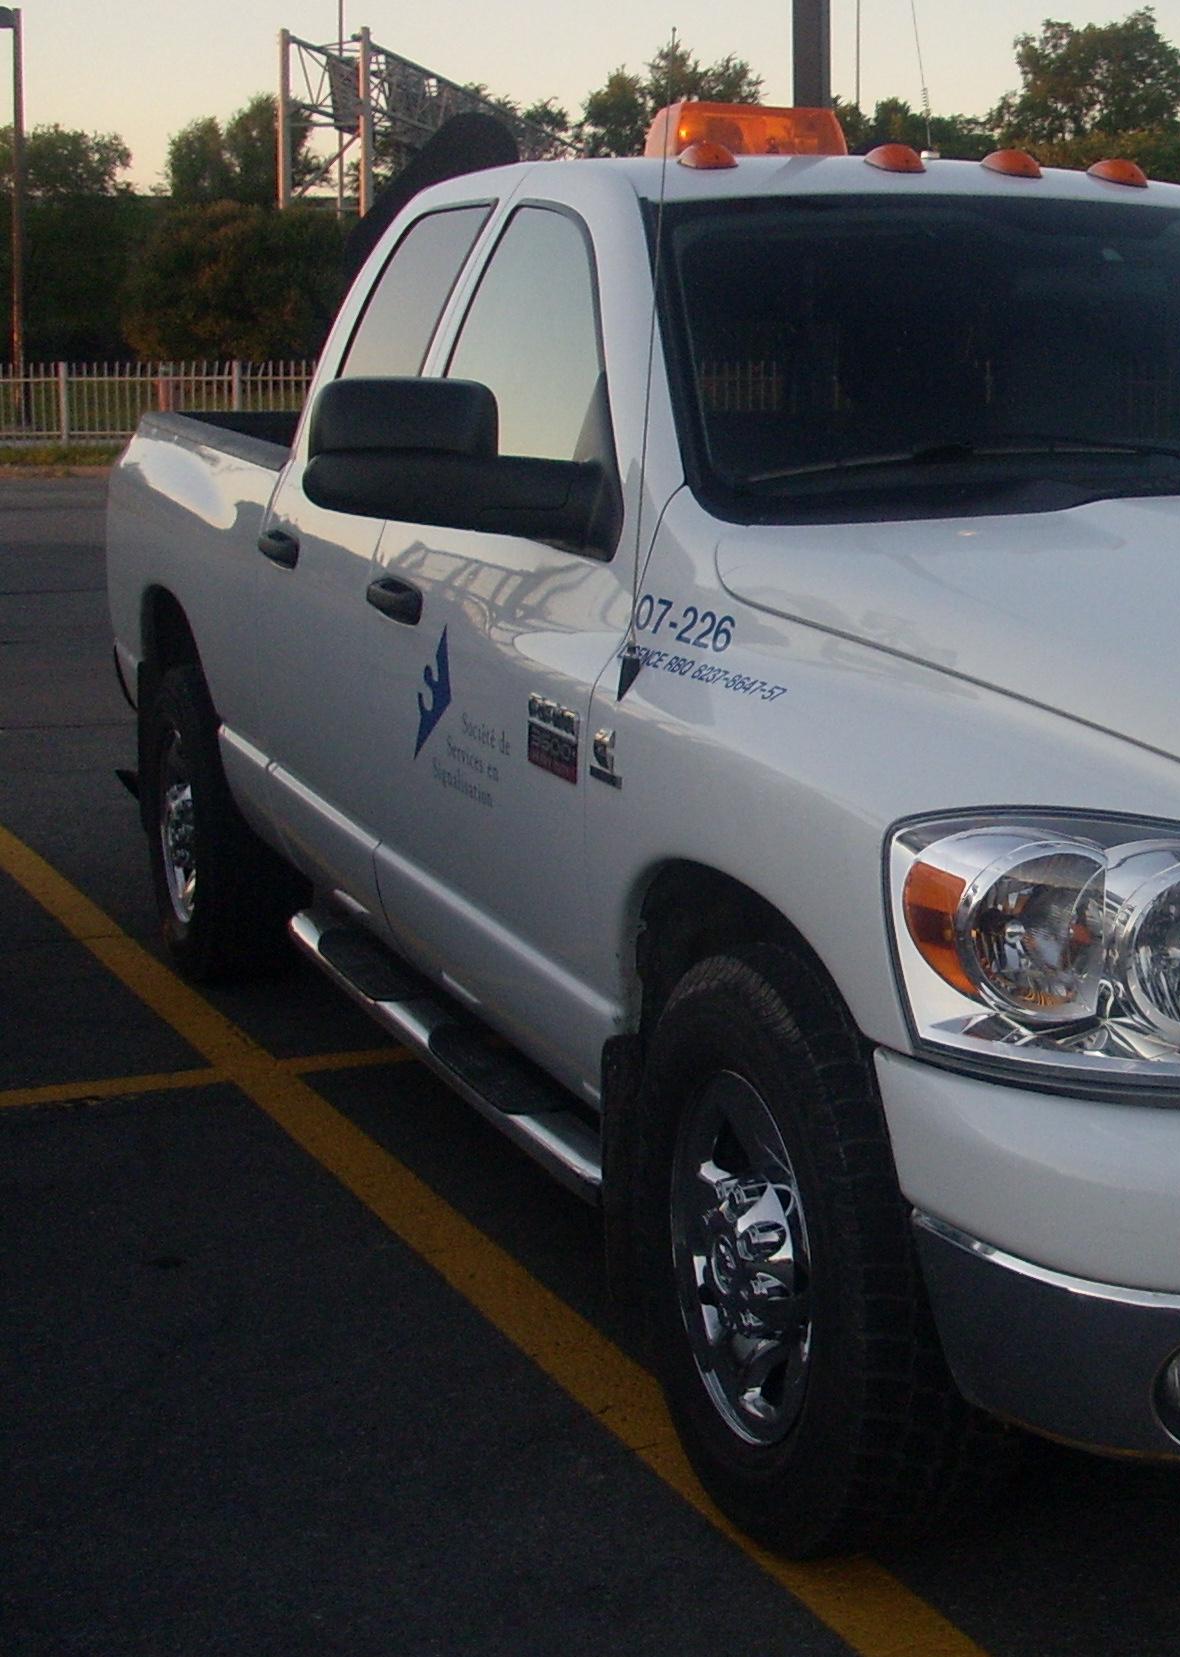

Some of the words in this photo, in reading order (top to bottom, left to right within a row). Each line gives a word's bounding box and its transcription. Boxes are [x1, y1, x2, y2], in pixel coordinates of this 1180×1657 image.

[636, 595, 736, 653] 07-226
[691, 663, 788, 702] 8237-8647-57
[446, 735, 483, 774] Services
[499, 729, 511, 756] de
